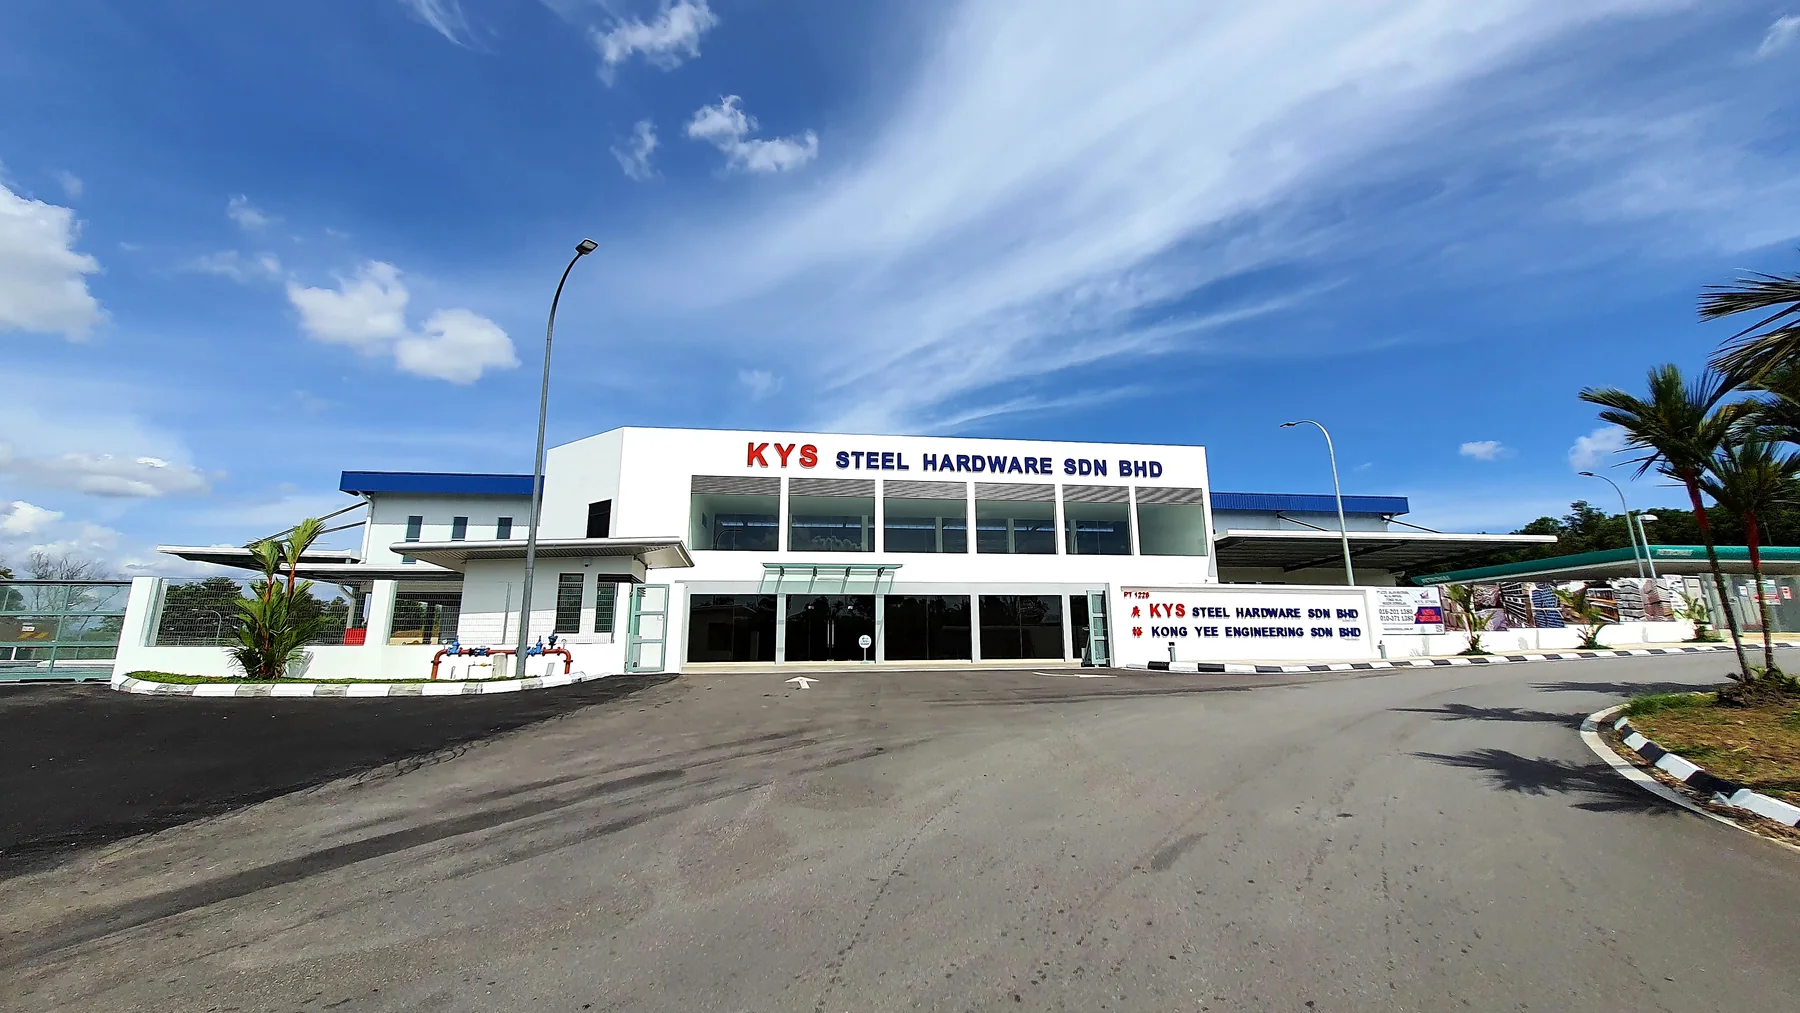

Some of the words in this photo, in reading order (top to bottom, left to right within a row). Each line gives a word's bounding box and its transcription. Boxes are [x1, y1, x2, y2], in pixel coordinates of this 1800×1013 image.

[747, 442, 818, 468] KYS
[836, 451, 909, 470] STEEL
[923, 454, 1053, 475] HARDWARE
[1064, 458, 1108, 476] SDN
[1119, 460, 1163, 478] BHD
[1149, 603, 1186, 618] KYS
[1192, 607, 1230, 618] STEEL
[1236, 607, 1302, 618] HARDWARE
[1308, 608, 1331, 619] SDN
[1336, 608, 1359, 619] BHD
[1151, 626, 1188, 637] KONG
[1194, 626, 1219, 637] YEE
[1225, 627, 1304, 637] ENGINEERING
[1310, 627, 1333, 637] SDN
[1339, 628, 1361, 637] BHD
